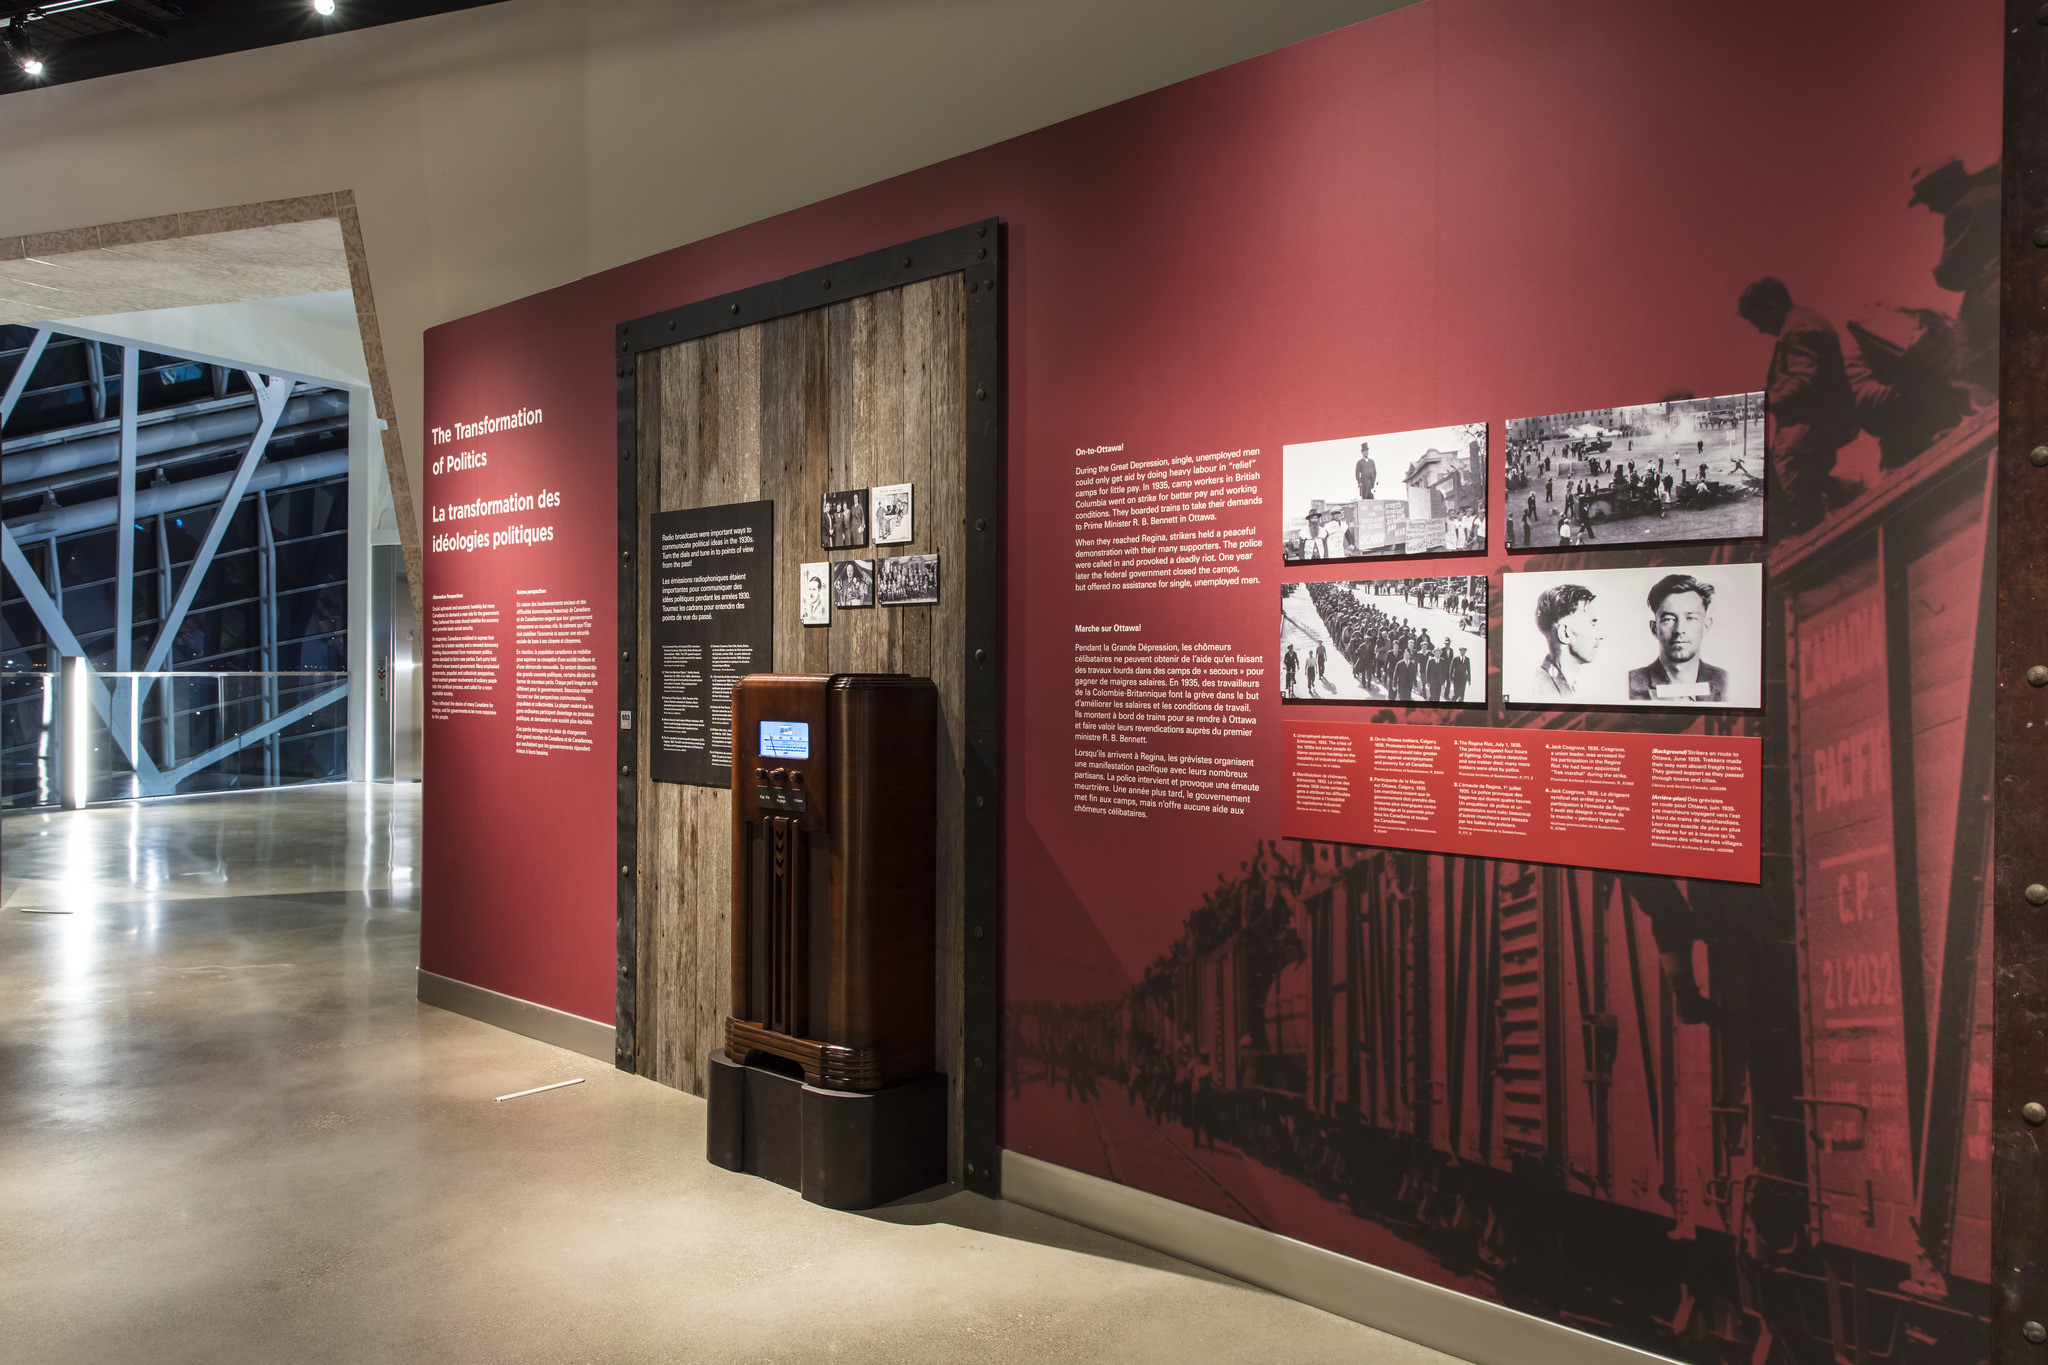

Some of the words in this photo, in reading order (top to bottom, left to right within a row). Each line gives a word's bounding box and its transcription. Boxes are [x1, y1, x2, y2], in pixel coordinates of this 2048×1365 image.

[432, 427, 451, 445] The
[454, 407, 542, 440] Transformation
[1076, 443, 1124, 456] On-to-Ottawa!
[433, 457, 444, 475] of
[447, 450, 487, 472] Politics
[1076, 466, 1097, 475] During
[1099, 465, 1109, 473] the
[1110, 463, 1129, 472] Great
[1130, 459, 1170, 470] Depression,
[1171, 455, 1194, 466] single,
[1196, 449, 1241, 462] unemployed
[1243, 449, 1260, 457] men
[1075, 490, 1097, 498] camps
[1099, 487, 1109, 495] for
[1110, 486, 1125, 494] little
[1127, 486, 1141, 494] pay.
[1143, 483, 1150, 491] In
[1152, 481, 1170, 490] 1935,
[1172, 480, 1193, 488] camp
[1194, 477, 1224, 486] workers
[1226, 475, 1233, 483] in
[1235, 472, 1260, 482] British
[1076, 477, 1094, 486] could
[1095, 476, 1110, 485] only
[1112, 475, 1123, 485] get
[1124, 473, 1135, 482] aid
[1137, 472, 1146, 481] by
[1147, 470, 1168, 479] doing
[1169, 469, 1192, 477] heavy
[1193, 465, 1217, 474] labour
[1219, 463, 1226, 471] in
[433, 506, 445, 522] La
[449, 493, 533, 520] transformation
[538, 489, 560, 508] des
[1076, 499, 1107, 509] Columbia
[1108, 498, 1125, 506] went
[1138, 494, 1157, 503] strike
[1159, 493, 1169, 501] for
[1171, 492, 1192, 500] better
[1194, 491, 1208, 500] pay
[1210, 487, 1224, 497] and
[1226, 485, 1257, 495] working
[1075, 510, 1110, 520] conditions.
[1113, 508, 1129, 517] They
[1131, 505, 1159, 515] boarded
[1161, 504, 1181, 513] trains
[1191, 501, 1207, 510] take
[1208, 499, 1225, 509] their
[1227, 496, 1263, 507] demands
[1084, 522, 1103, 530] Prime
[1104, 520, 1131, 528] Minister
[1133, 518, 1140, 526] R.
[1142, 517, 1149, 526] B.
[1151, 516, 1178, 525] Bennett
[1180, 515, 1187, 523] in
[1188, 514, 1217, 522] Ottawa.
[433, 530, 490, 552] idéologies
[493, 525, 553, 550] politiques
[1075, 539, 1095, 547] When
[1096, 538, 1111, 546] they
[1113, 535, 1140, 544] reached
[1142, 534, 1168, 544] Regina,
[1170, 532, 1196, 541] strikers
[1198, 530, 1215, 538] held
[1223, 526, 1256, 539] peaceful
[1075, 548, 1123, 558] demonstration
[1124, 547, 1139, 555] with
[1141, 546, 1156, 554] their
[1158, 546, 1178, 554] many
[1180, 543, 1221, 553] supporters.
[1223, 540, 1238, 549] The
[1239, 539, 1263, 550] police
[1093, 560, 1112, 568] called
[1114, 559, 1120, 567] in
[1122, 558, 1135, 567] and
[1136, 557, 1168, 567] provoked
[1176, 555, 1200, 564] deadly
[1202, 554, 1216, 562] riot.
[1218, 553, 1234, 561] One
[1236, 553, 1253, 562] year
[1087, 582, 1111, 591] offered
[1122, 581, 1157, 589] assistance
[1158, 580, 1168, 588] for
[1170, 579, 1192, 589] single,
[1194, 576, 1239, 587] unemployed
[1104, 570, 1127, 579] federal
[1129, 569, 1171, 580] government
[1173, 567, 1197, 576] closed
[1199, 566, 1211, 575] the
[1212, 566, 1240, 575] camps,
[1114, 624, 1141, 632] Ottawa!
[1075, 644, 1102, 652] Pendant
[1104, 644, 1110, 652] la
[1111, 643, 1137, 652] Grande
[1138, 643, 1180, 653] Dépression,
[1182, 643, 1192, 651] les
[1194, 643, 1232, 651] chômeurs
[1075, 655, 1112, 663] célibataires
[1124, 656, 1152, 664] peuvent
[1154, 655, 1179, 663] obtenir
[1181, 655, 1191, 663] de
[1237, 654, 1263, 663] faisant
